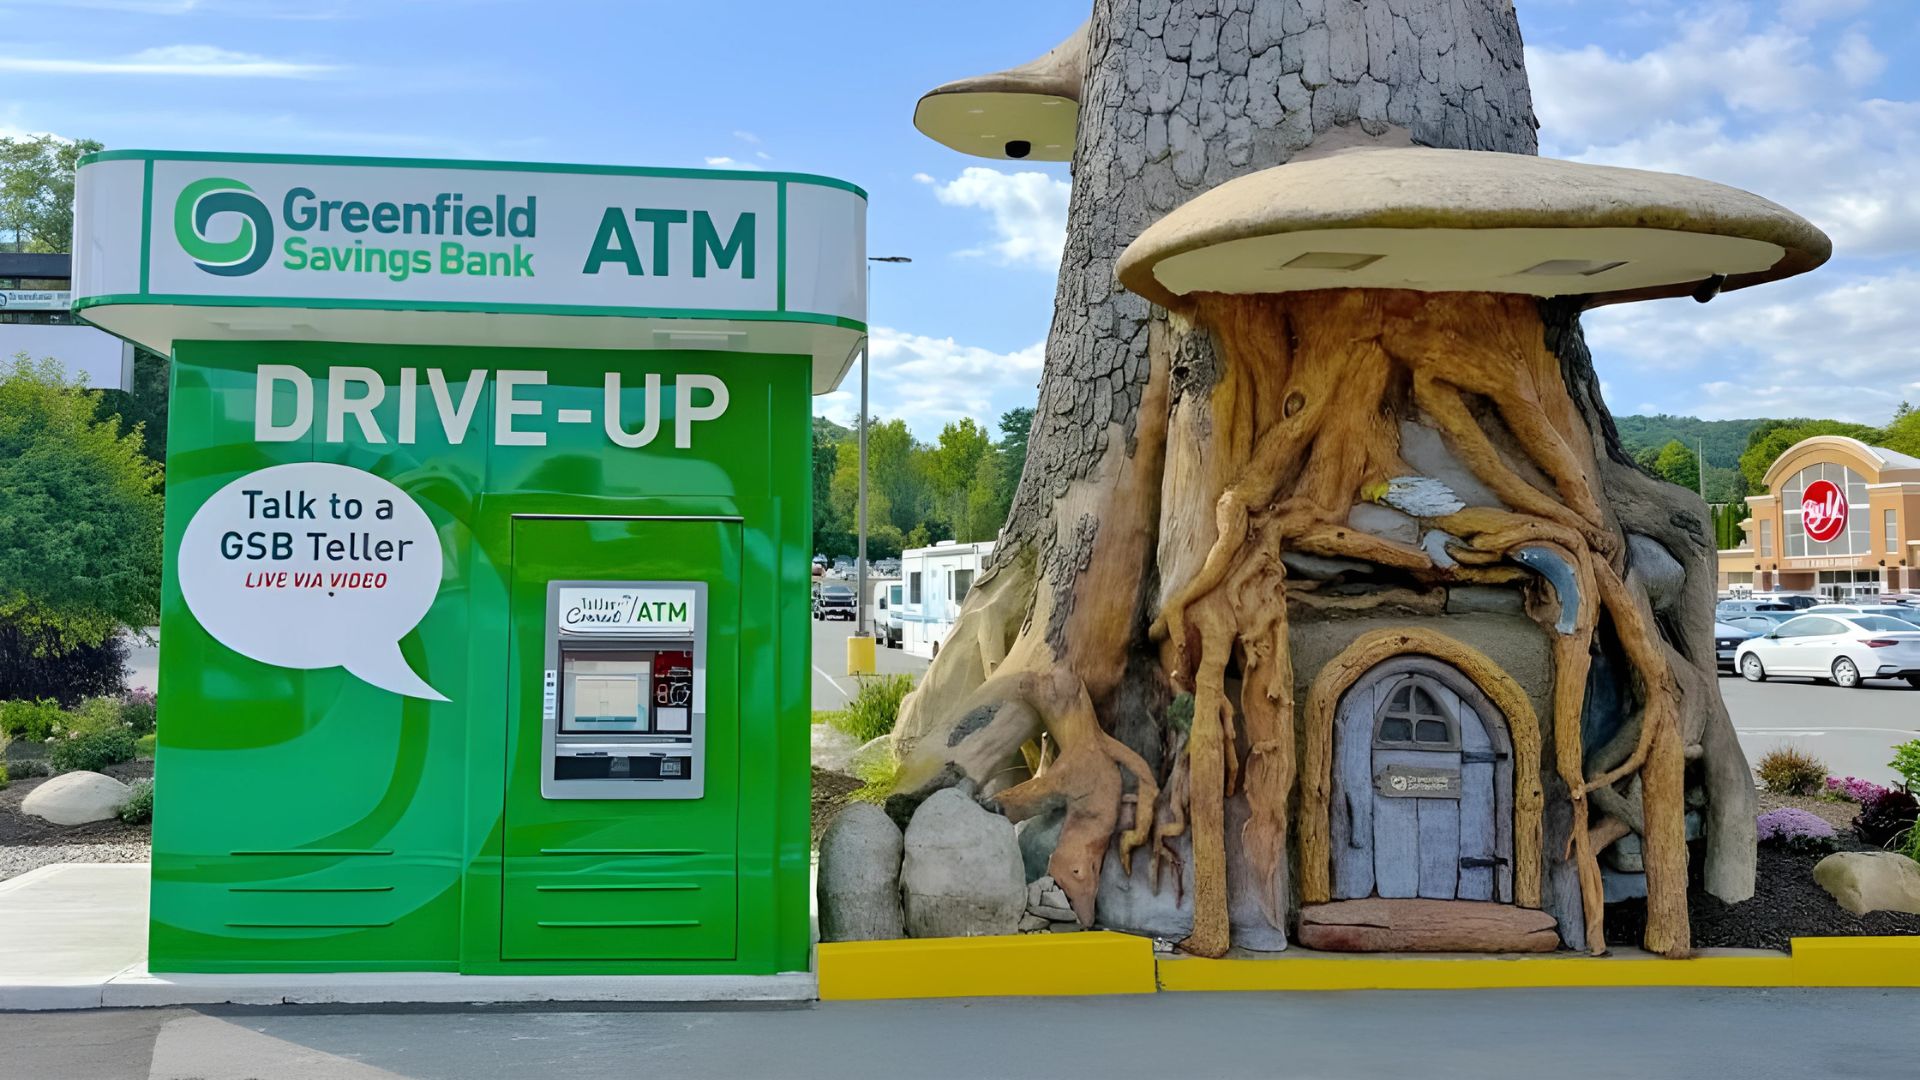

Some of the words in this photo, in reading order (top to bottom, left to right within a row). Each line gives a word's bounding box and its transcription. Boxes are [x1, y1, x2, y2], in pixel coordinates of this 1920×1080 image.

[283, 187, 536, 238] Greenfield
[283, 236, 432, 282] Savings
[439, 241, 535, 277] Bank
[582, 207, 756, 279] ATM
[254, 364, 730, 449] DRIVE-UP
[242, 490, 316, 519] Talk
[329, 493, 362, 520] to
[375, 499, 394, 520] a
[220, 531, 293, 560] GSB
[306, 533, 414, 562] Teller
[245, 572, 288, 588] LIVE
[294, 572, 323, 588] VIA
[330, 572, 388, 589] VIDEO
